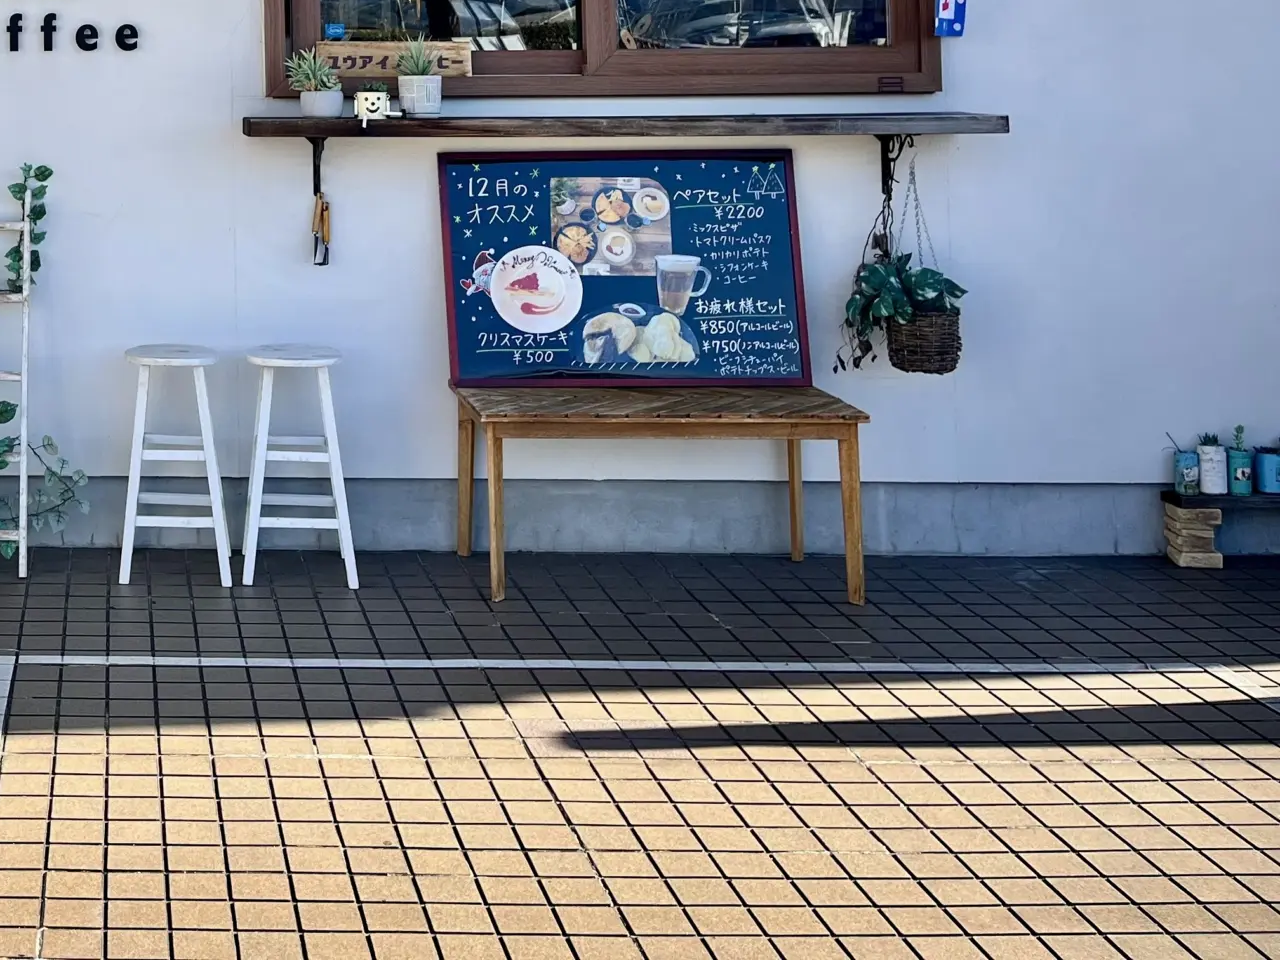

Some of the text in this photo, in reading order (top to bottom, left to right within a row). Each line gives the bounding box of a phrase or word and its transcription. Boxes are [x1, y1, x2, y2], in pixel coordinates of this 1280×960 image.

[327, 54, 464, 70] ユウアイヒー
[468, 177, 528, 197] 12月の
[673, 188, 741, 204] ペアセット
[466, 203, 535, 225] オススメ
[713, 204, 765, 220] ¥2200
[723, 275, 757, 285] コーヒー
[694, 297, 786, 315] お疲れ様セット
[478, 330, 568, 347] クリスマスケーキ
[513, 350, 554, 365] ¥500
